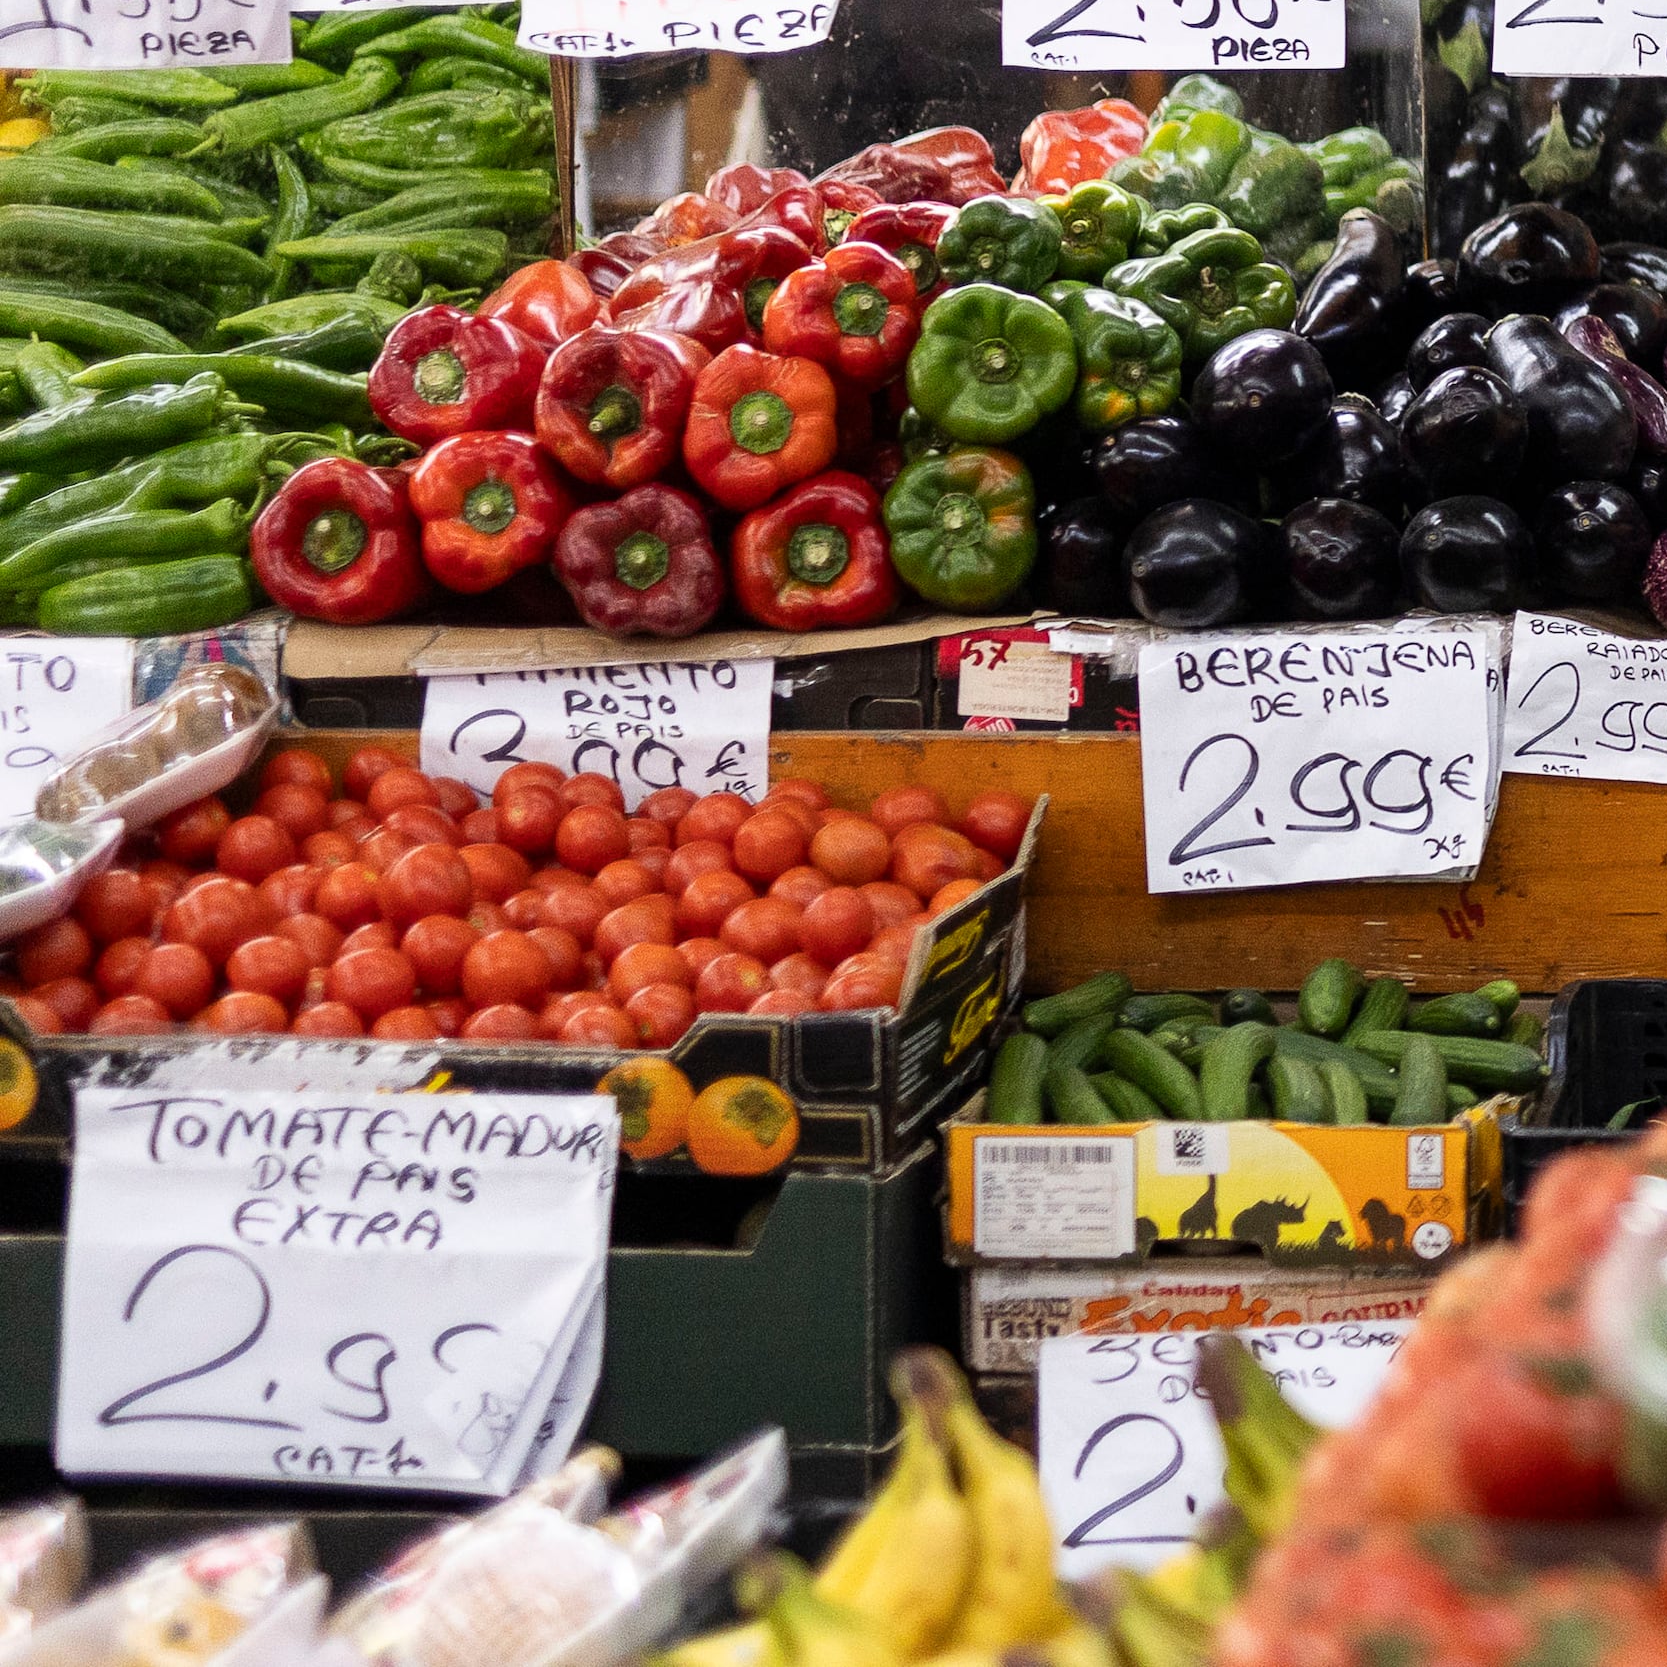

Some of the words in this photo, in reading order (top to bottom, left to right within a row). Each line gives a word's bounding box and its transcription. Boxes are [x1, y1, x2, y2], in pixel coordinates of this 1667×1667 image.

[140, 29, 256, 59] PIEZA
[1211, 35, 1310, 65] PIEZA
[1175, 641, 1476, 693] BERENJENA
[1609, 665, 1637, 681] DE
[563, 688, 677, 720] ROJO
[1250, 692, 1303, 723] DE
[1322, 685, 1390, 714] PAIS
[615, 721, 684, 740] PAIS
[249, 1153, 324, 1194] DE
[348, 1159, 477, 1204] PAIS
[231, 1196, 443, 1250] EXTRA
